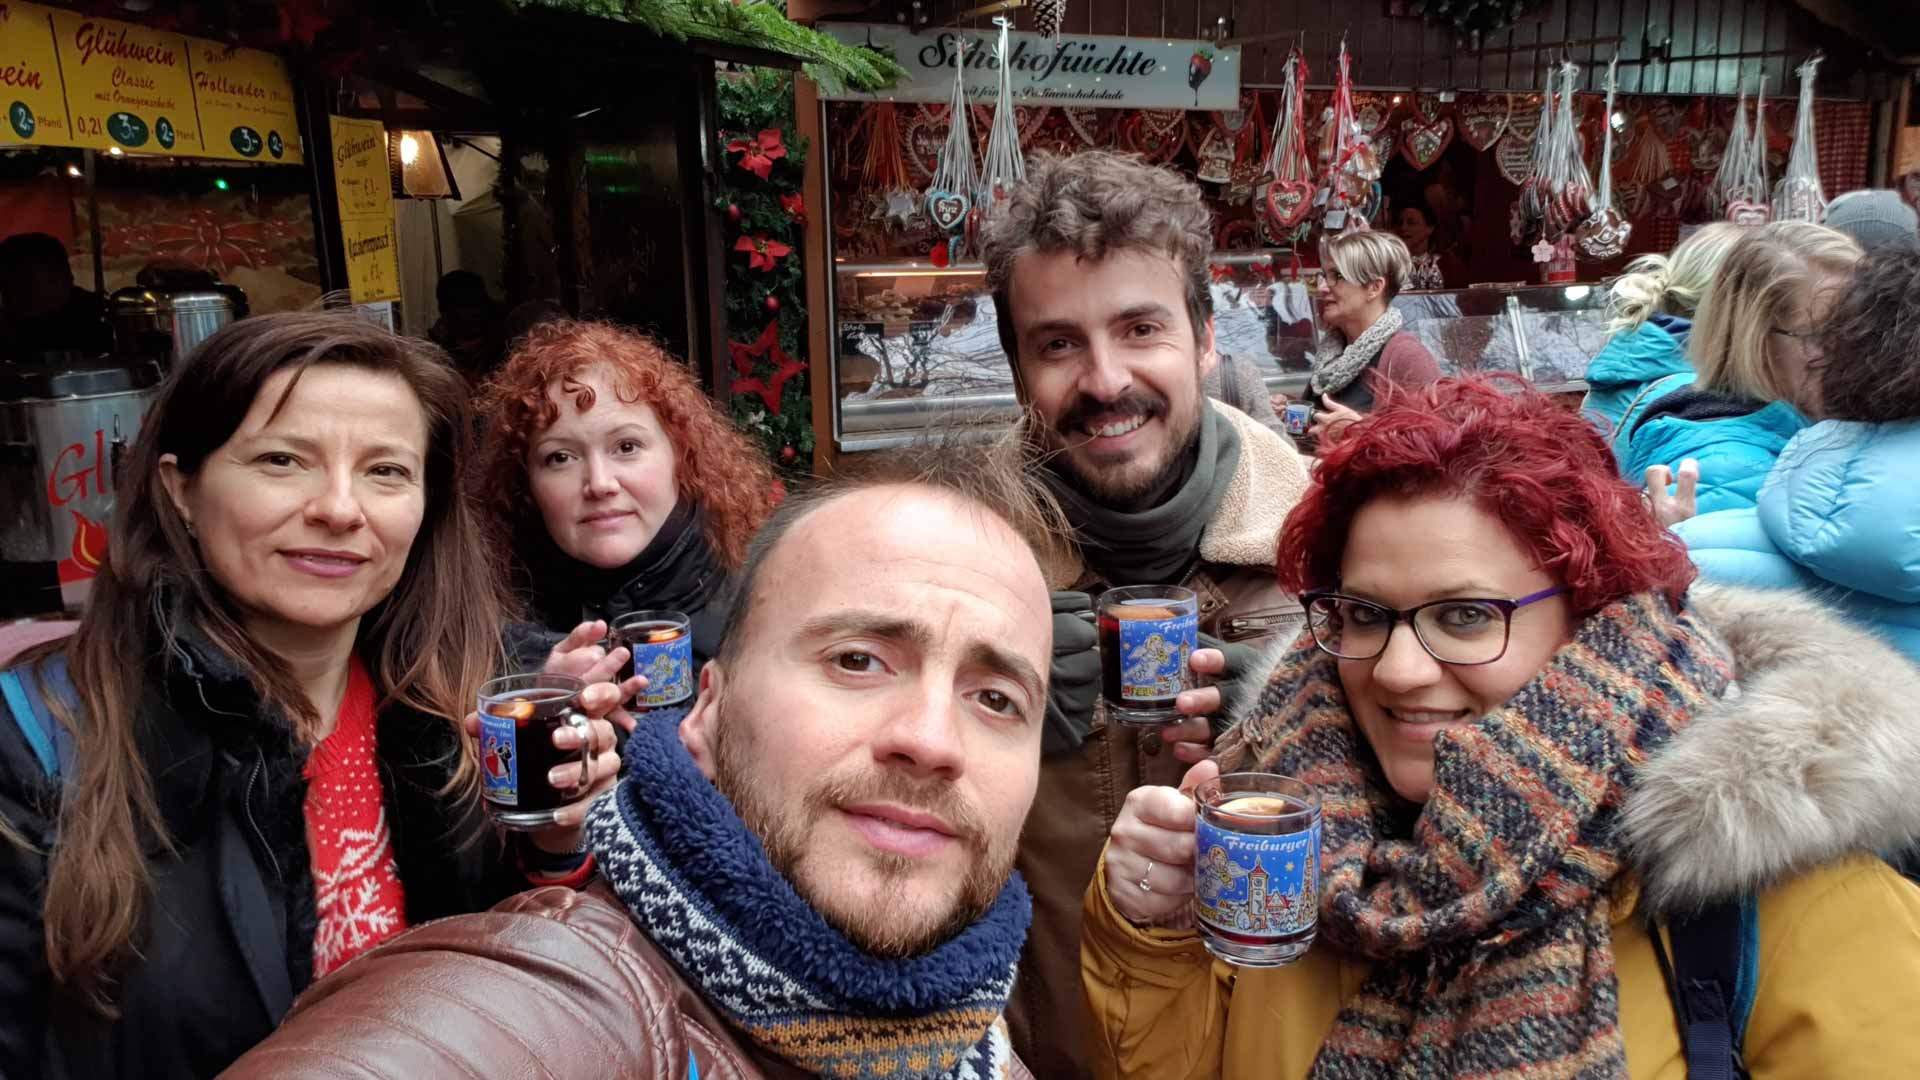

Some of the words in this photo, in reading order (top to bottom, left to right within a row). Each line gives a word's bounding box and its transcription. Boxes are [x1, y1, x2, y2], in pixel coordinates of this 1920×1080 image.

[75, 22, 176, 66] Glühwein
[111, 66, 156, 90] Classic
[1222, 834, 1309, 853] Freiburger
